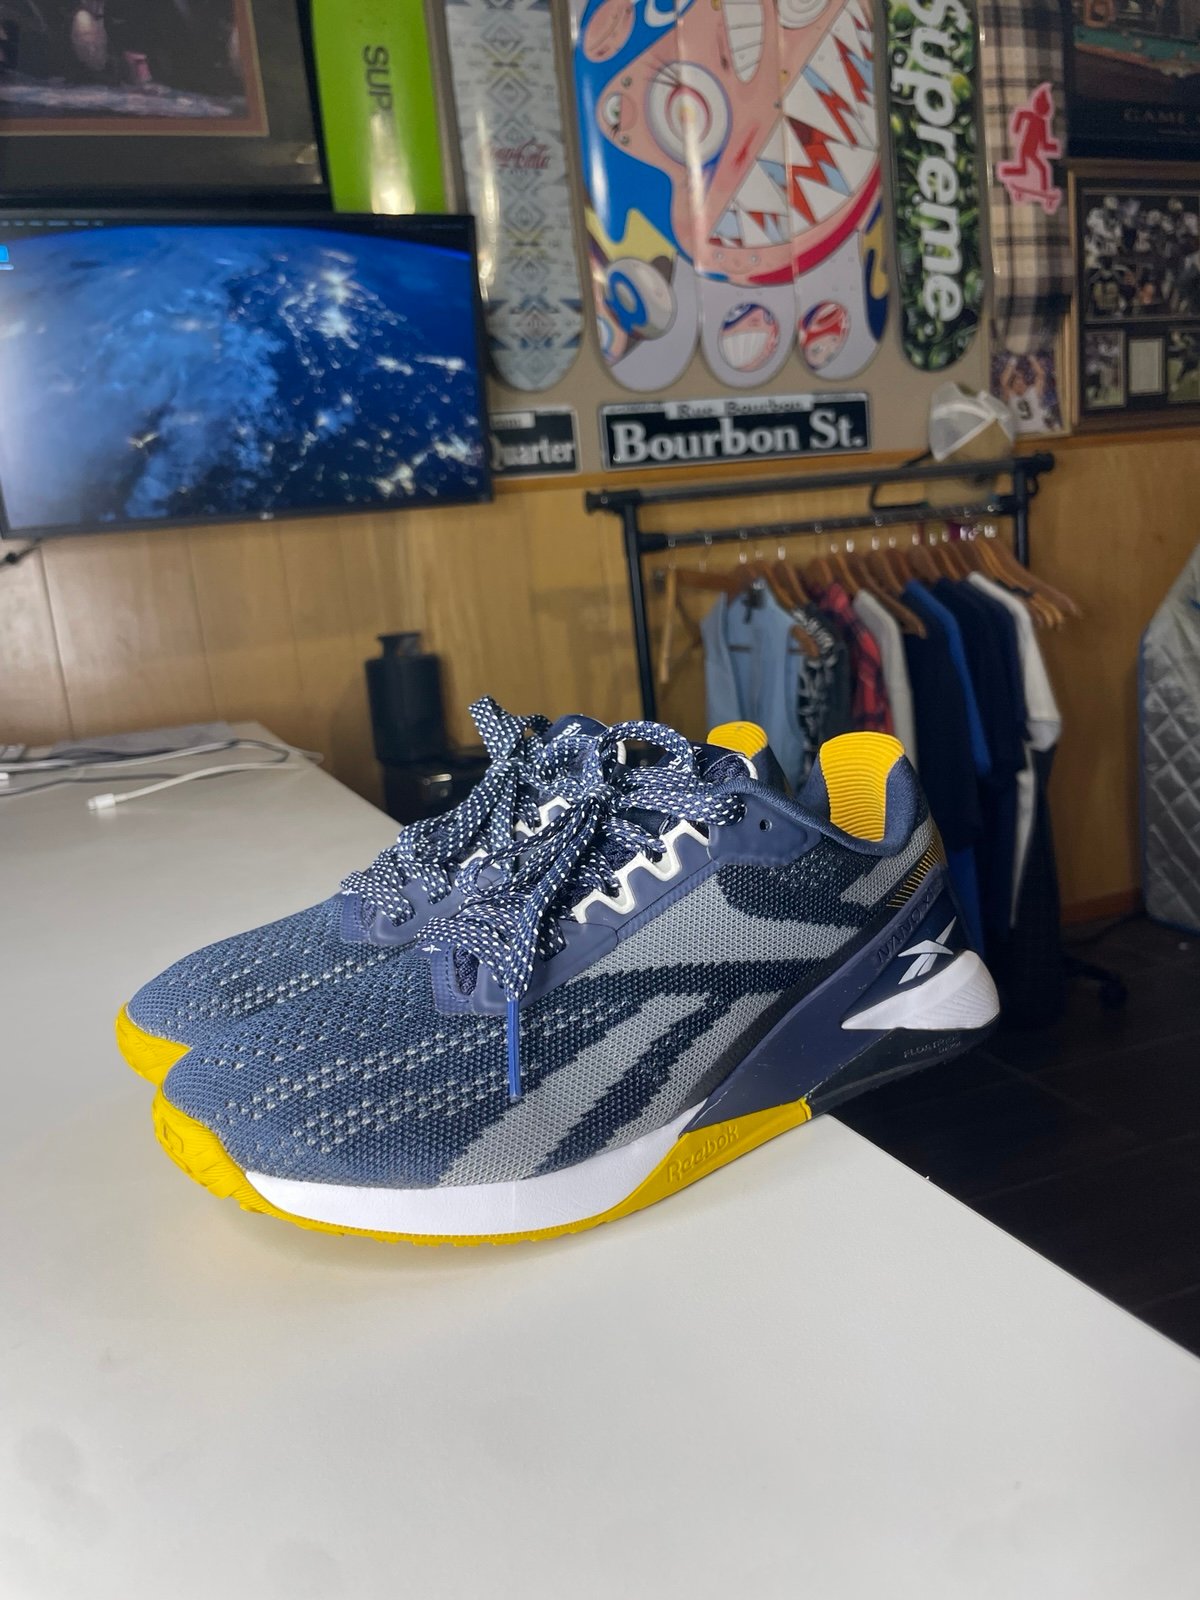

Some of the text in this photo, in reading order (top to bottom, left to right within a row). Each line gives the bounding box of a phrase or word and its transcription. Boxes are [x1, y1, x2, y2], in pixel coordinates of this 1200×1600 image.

[725, 399, 802, 416] Bourbon
[611, 409, 865, 463] Bourbon St.
[878, 904, 924, 963] NANO
[667, 1125, 740, 1183] Reebok
